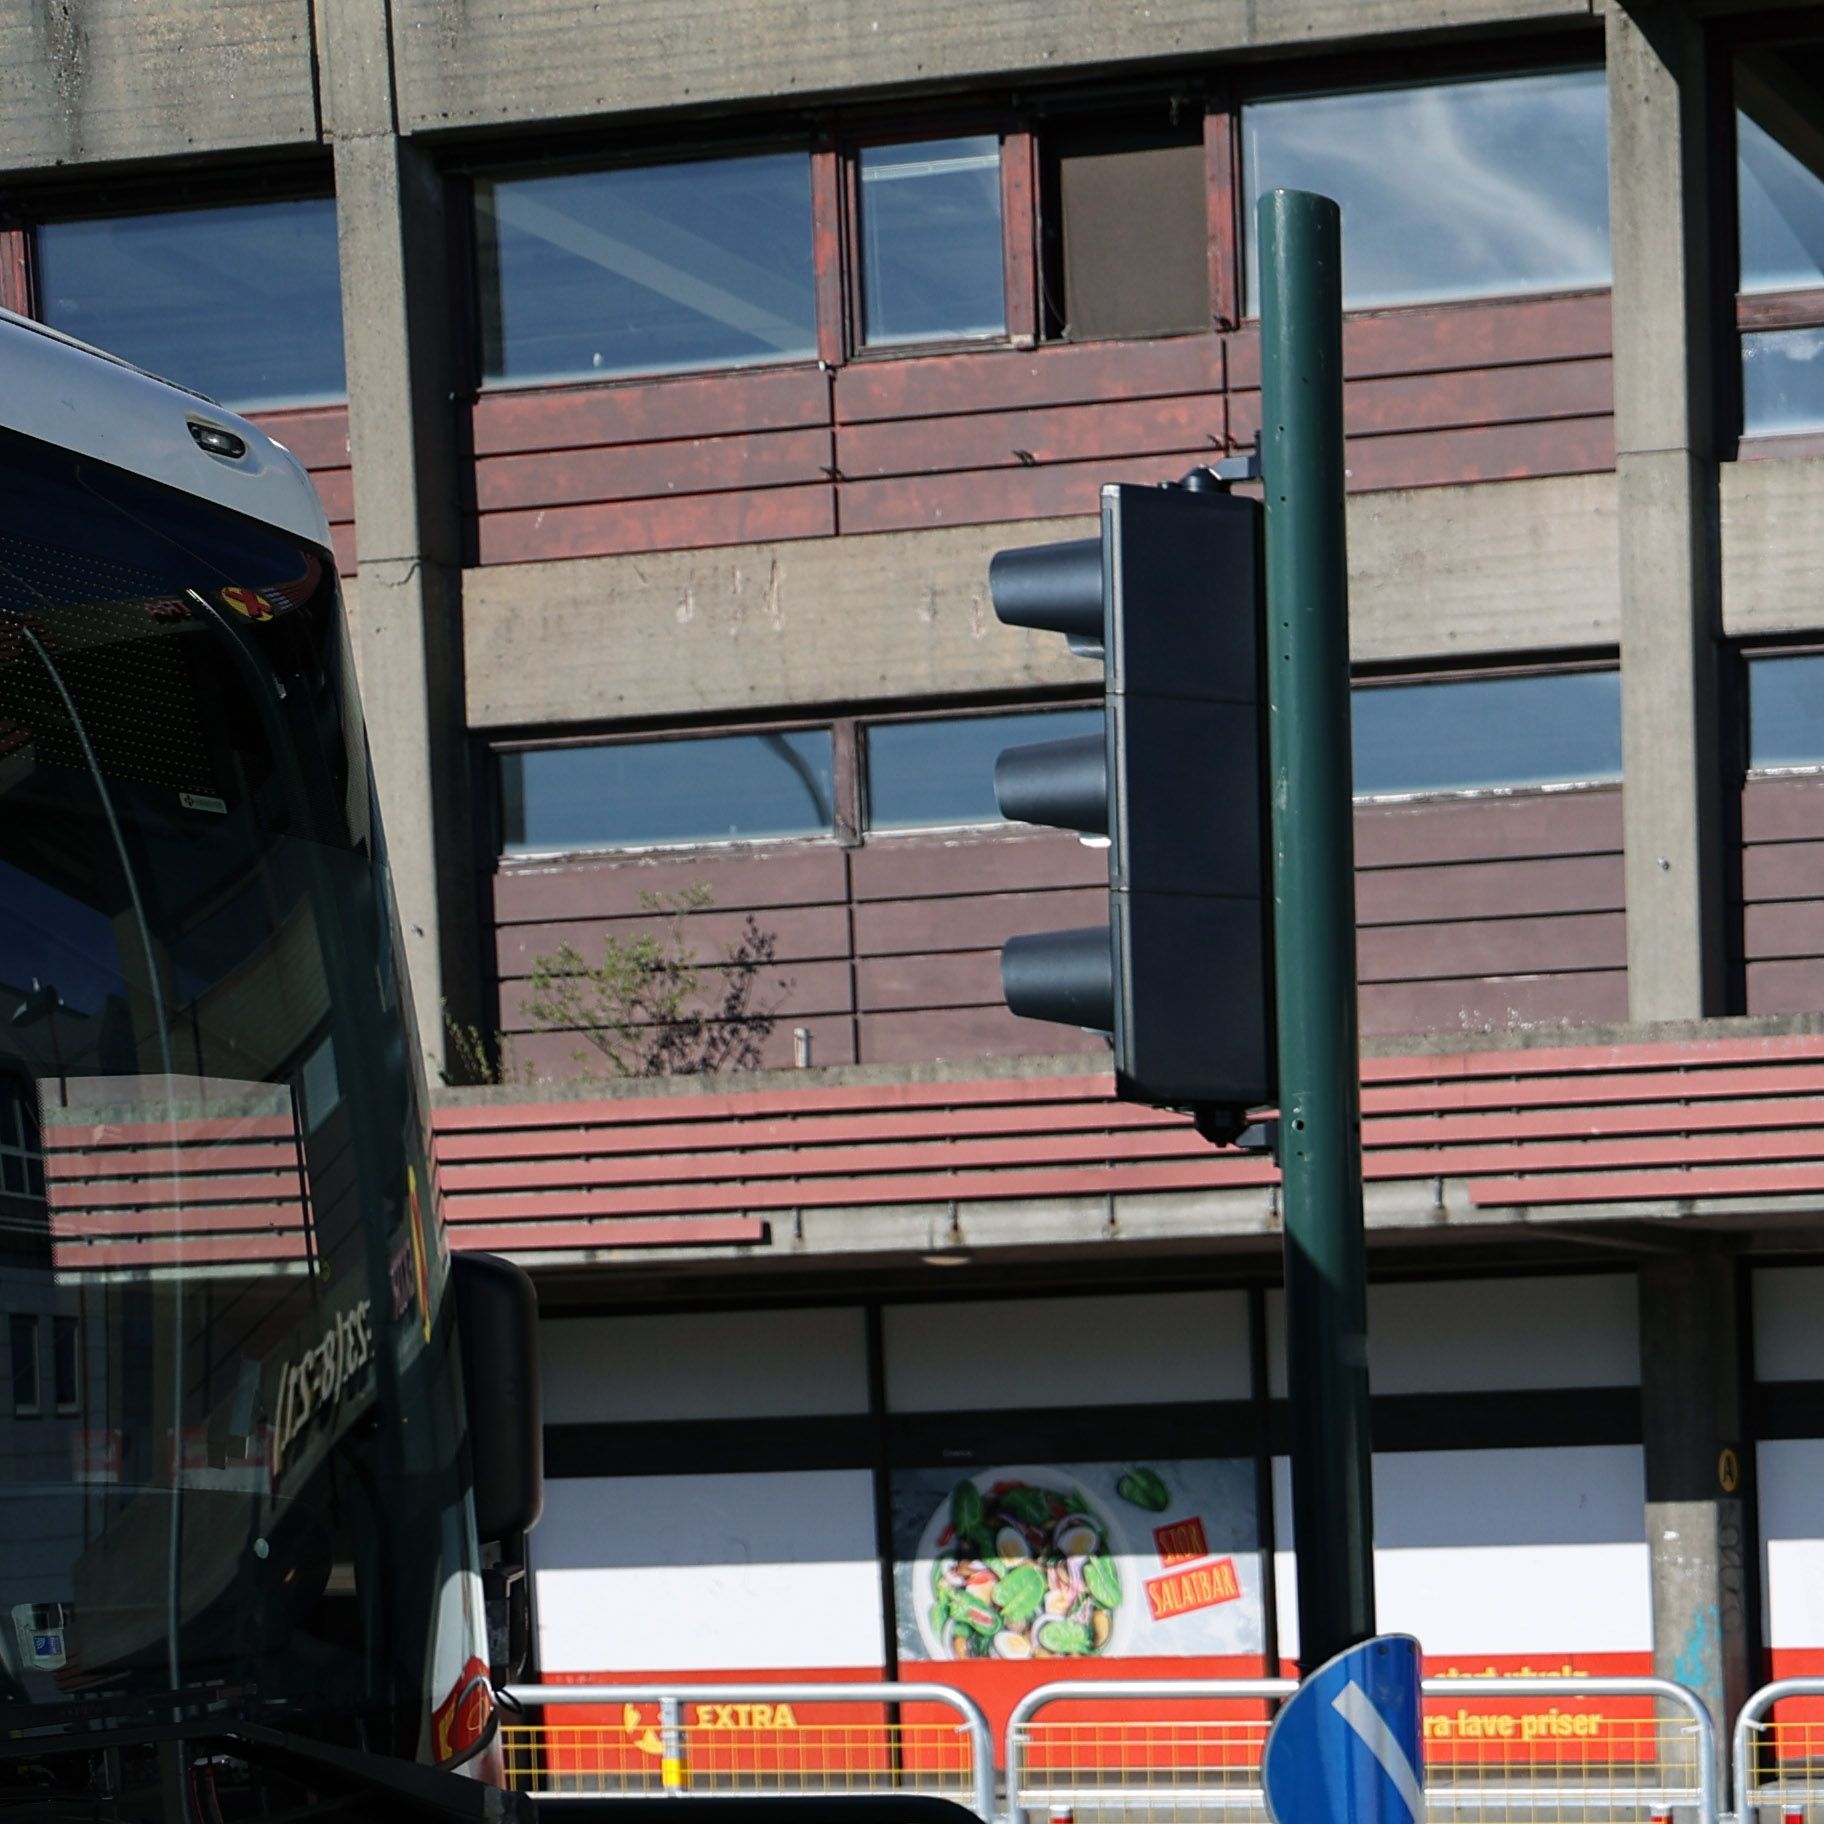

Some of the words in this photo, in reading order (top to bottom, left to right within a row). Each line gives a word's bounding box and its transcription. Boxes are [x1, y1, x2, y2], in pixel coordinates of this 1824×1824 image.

[1157, 1521, 1203, 1566] STOR
[1148, 1563, 1236, 1618] SALATBAR
[696, 1704, 798, 1729] EXTRA
[1456, 1707, 1513, 1737] lave
[1520, 1706, 1602, 1741] priser
